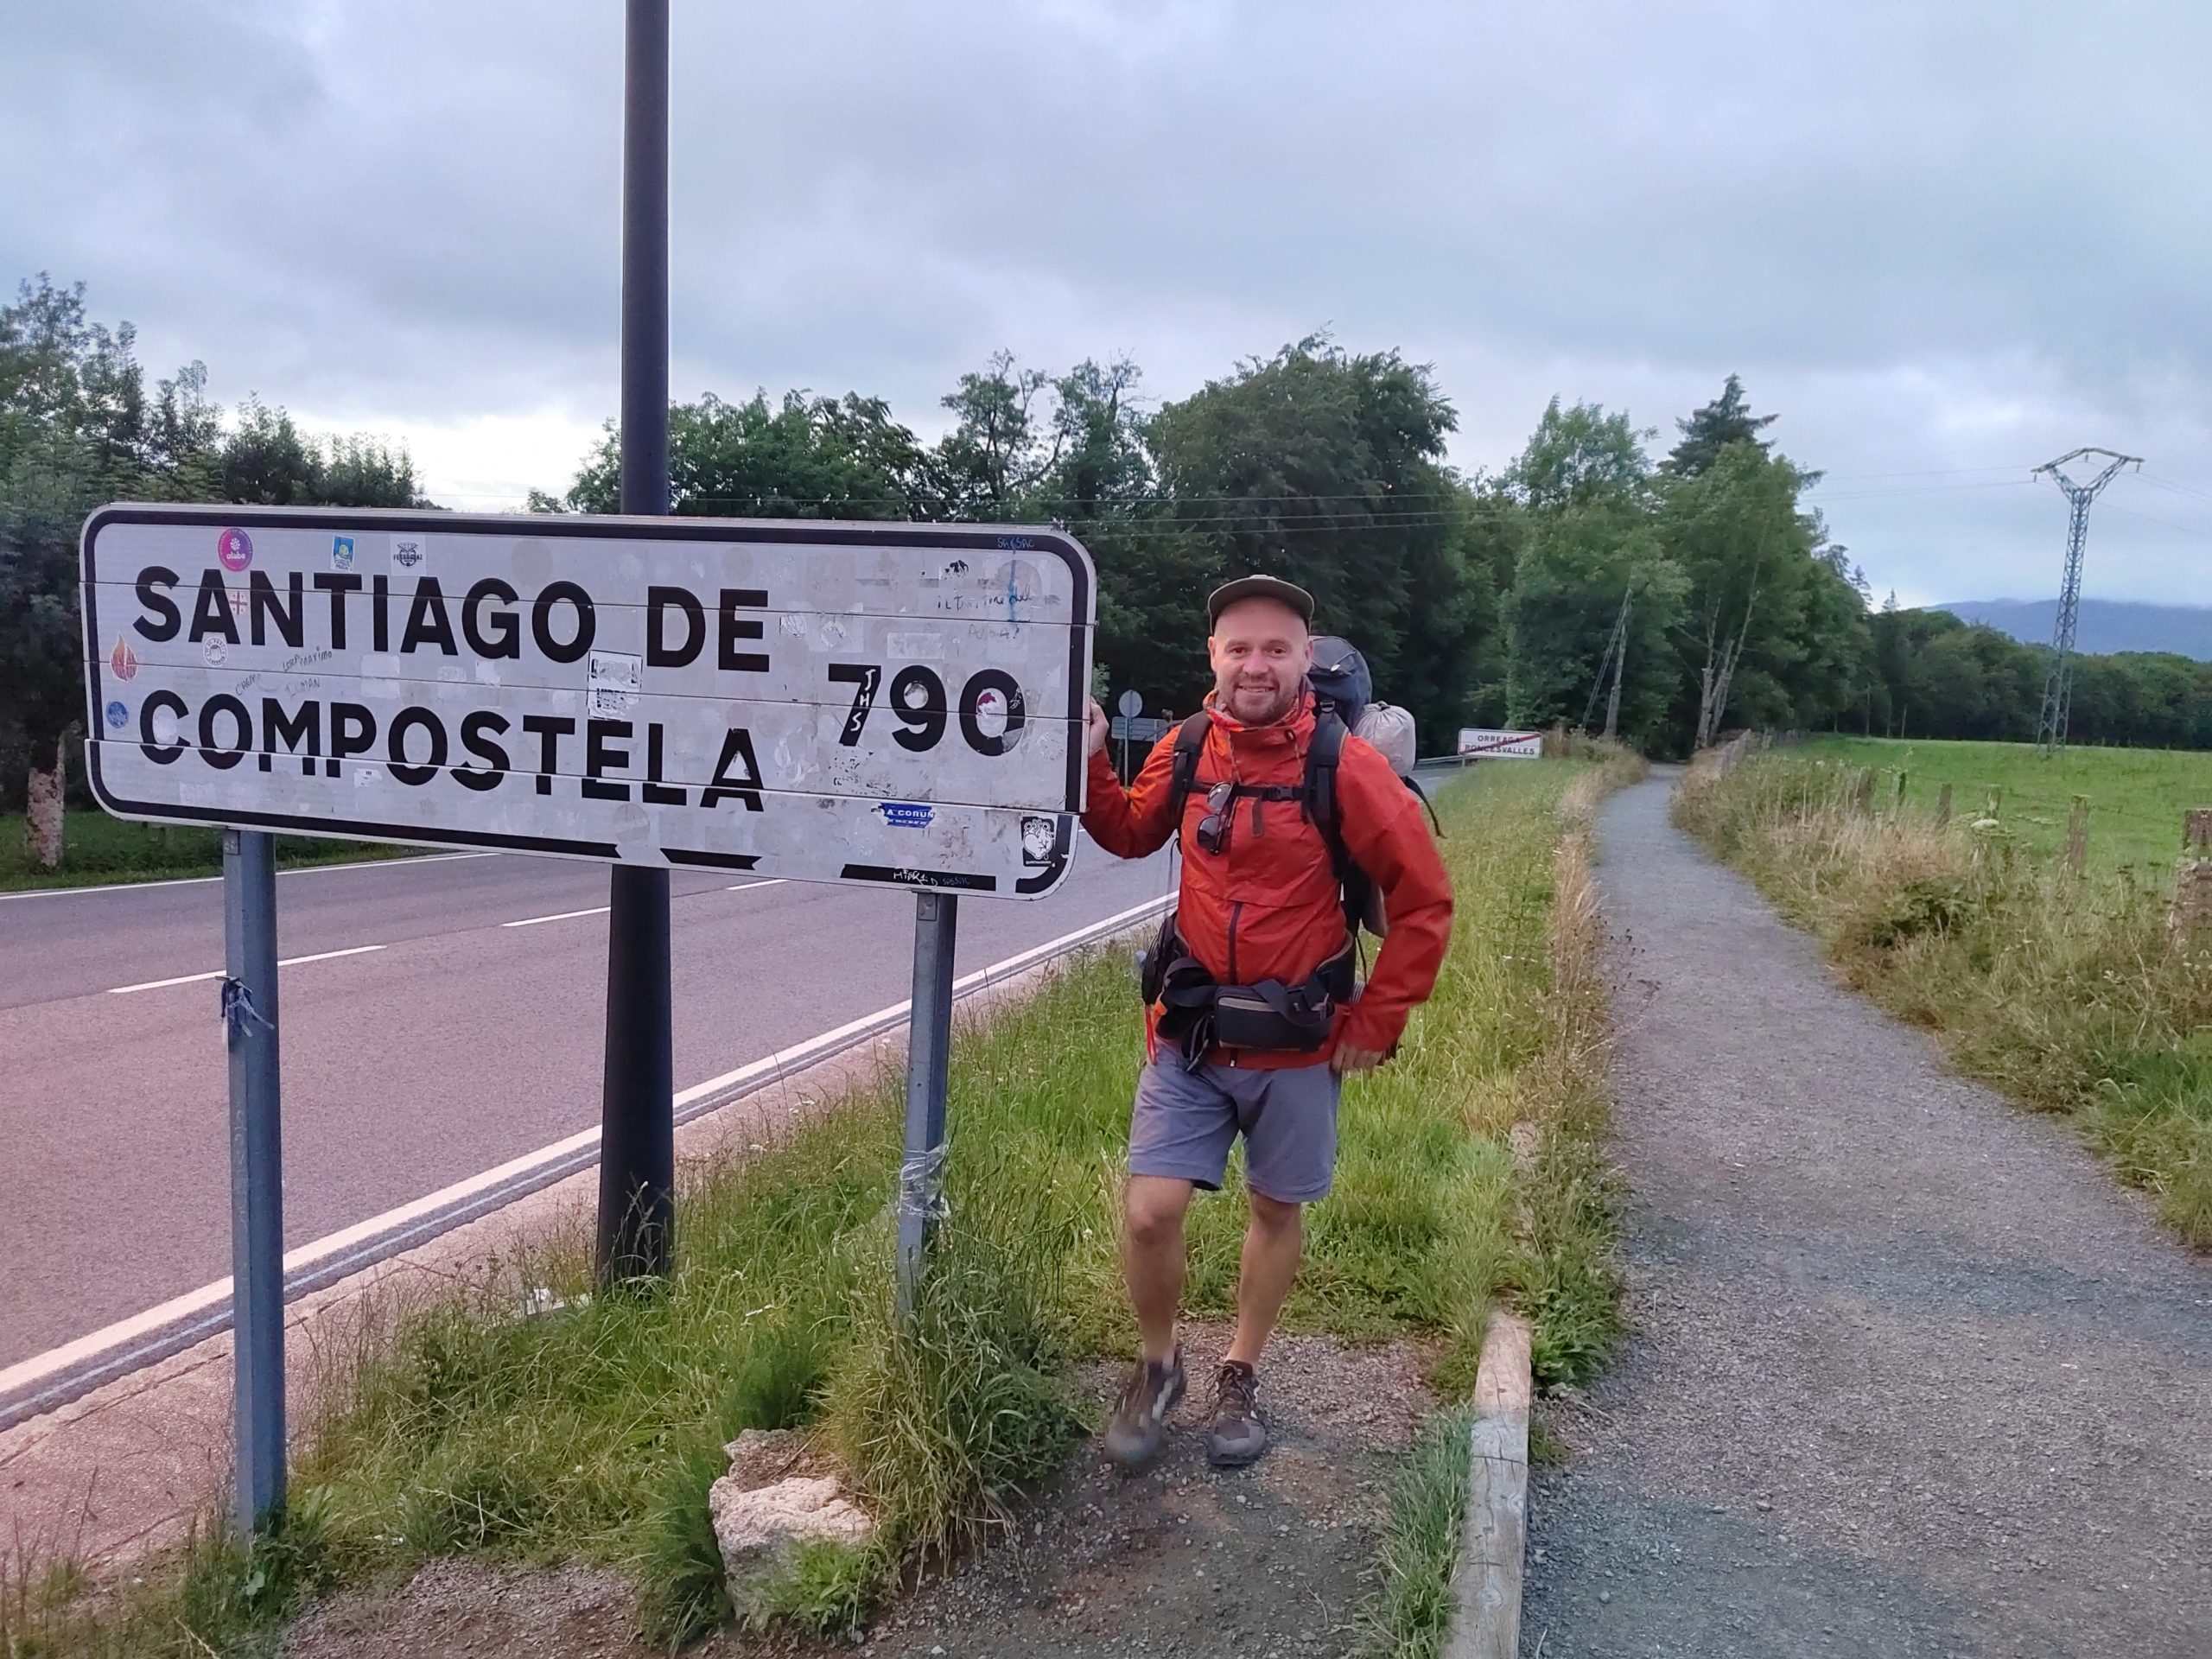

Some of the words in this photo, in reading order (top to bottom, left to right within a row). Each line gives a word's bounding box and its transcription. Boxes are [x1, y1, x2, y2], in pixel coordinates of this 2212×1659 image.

[132, 565, 597, 664] SANTIAGO
[646, 585, 771, 673] DE
[139, 690, 766, 812] COMPOSTELA
[828, 663, 1026, 757] 790
[1465, 744, 1535, 755] RONCESVALLES
[1477, 734, 1521, 744] ORREAGA
